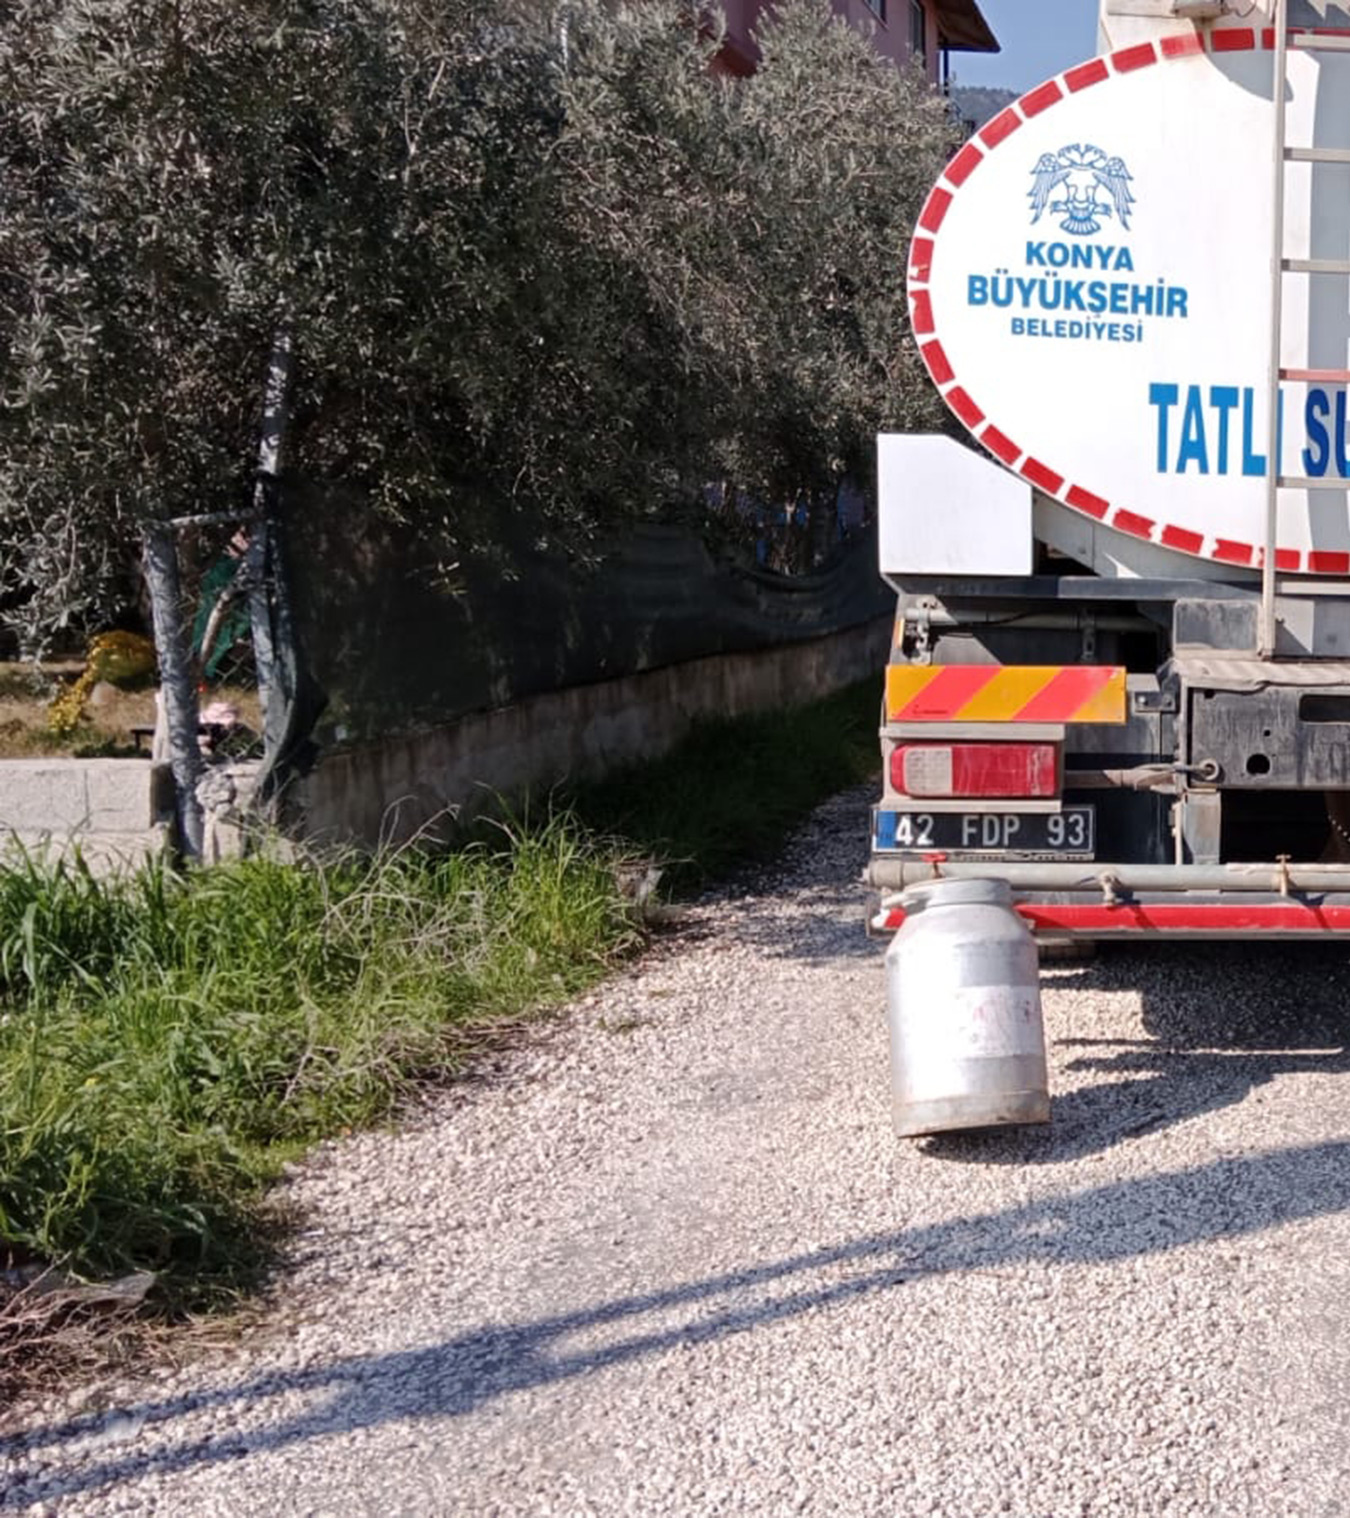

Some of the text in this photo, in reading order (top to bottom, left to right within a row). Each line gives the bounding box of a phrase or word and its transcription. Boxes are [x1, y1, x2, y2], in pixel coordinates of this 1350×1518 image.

[1026, 241, 1134, 271] KONYA
[967, 269, 1188, 317] BÜYÜKŞEHİR
[1011, 317, 1143, 342] BELEDİYESİ
[896, 814, 1085, 846] 42 FDP 93
